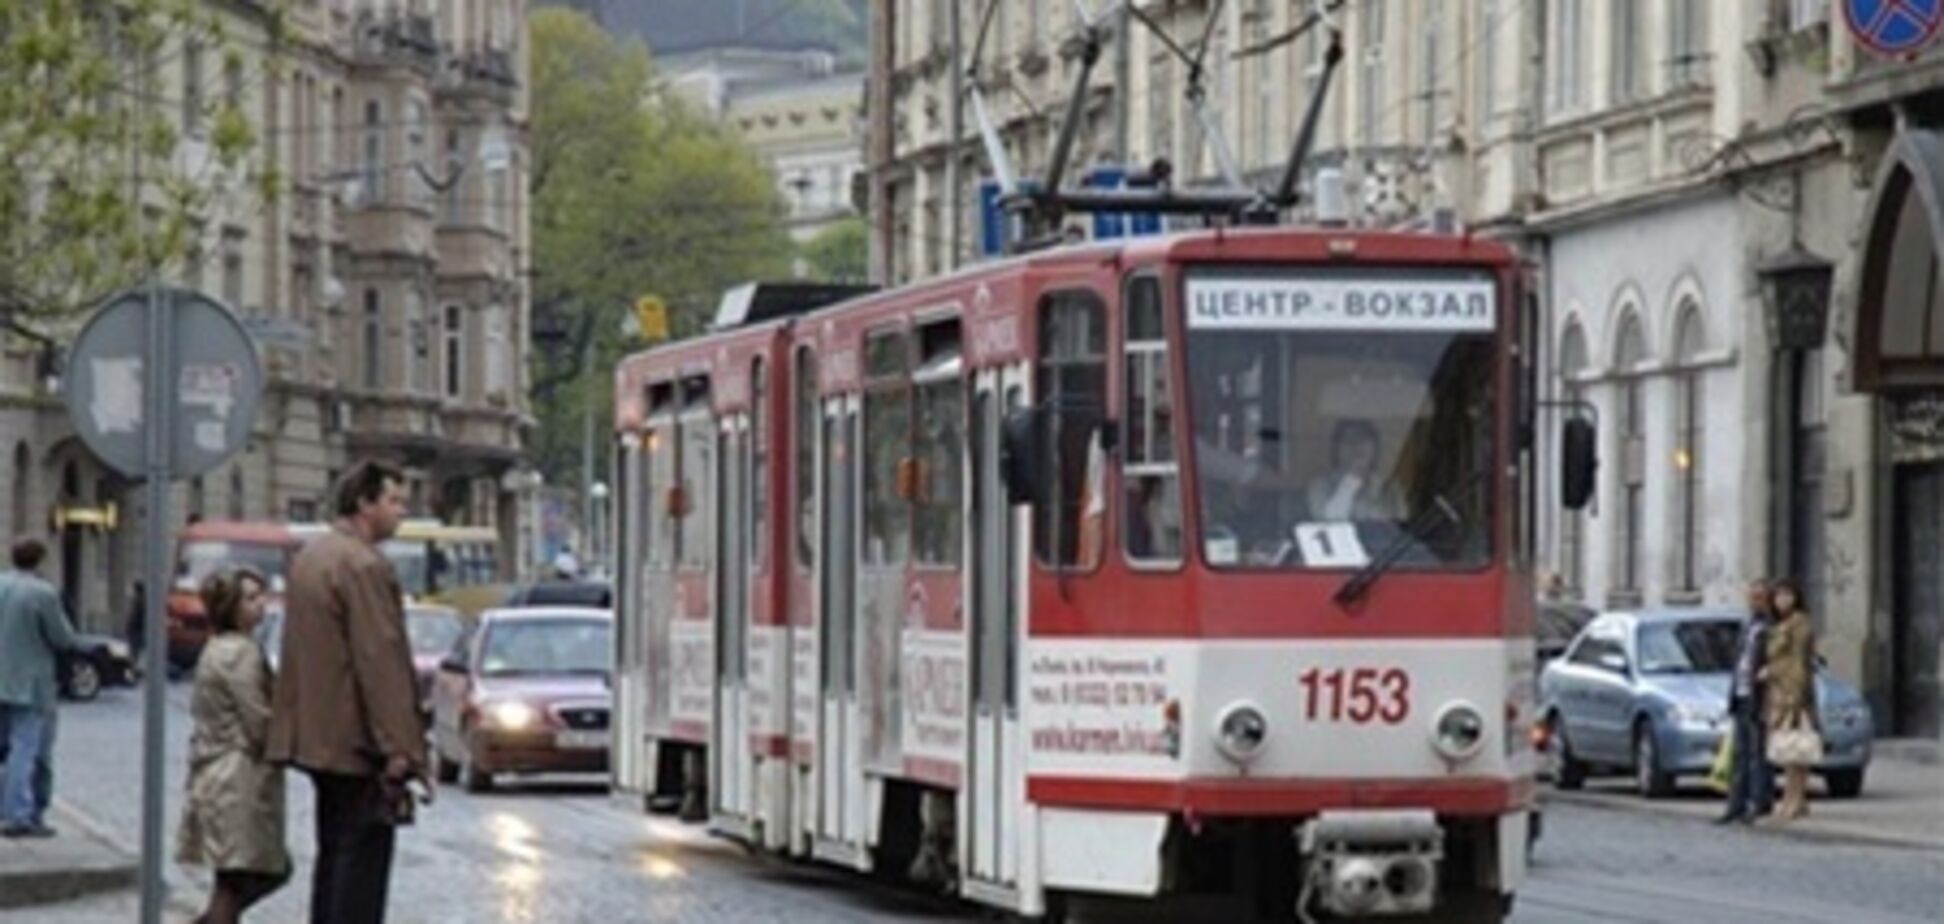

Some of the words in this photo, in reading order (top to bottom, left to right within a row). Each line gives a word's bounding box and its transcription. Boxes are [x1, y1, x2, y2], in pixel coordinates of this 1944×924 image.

[1196, 291, 1311, 320] ЦЕНТР
[1343, 291, 1488, 318] ВОКЗАЛ
[1313, 528, 1334, 557] 1
[1299, 666, 1410, 725] 1153
